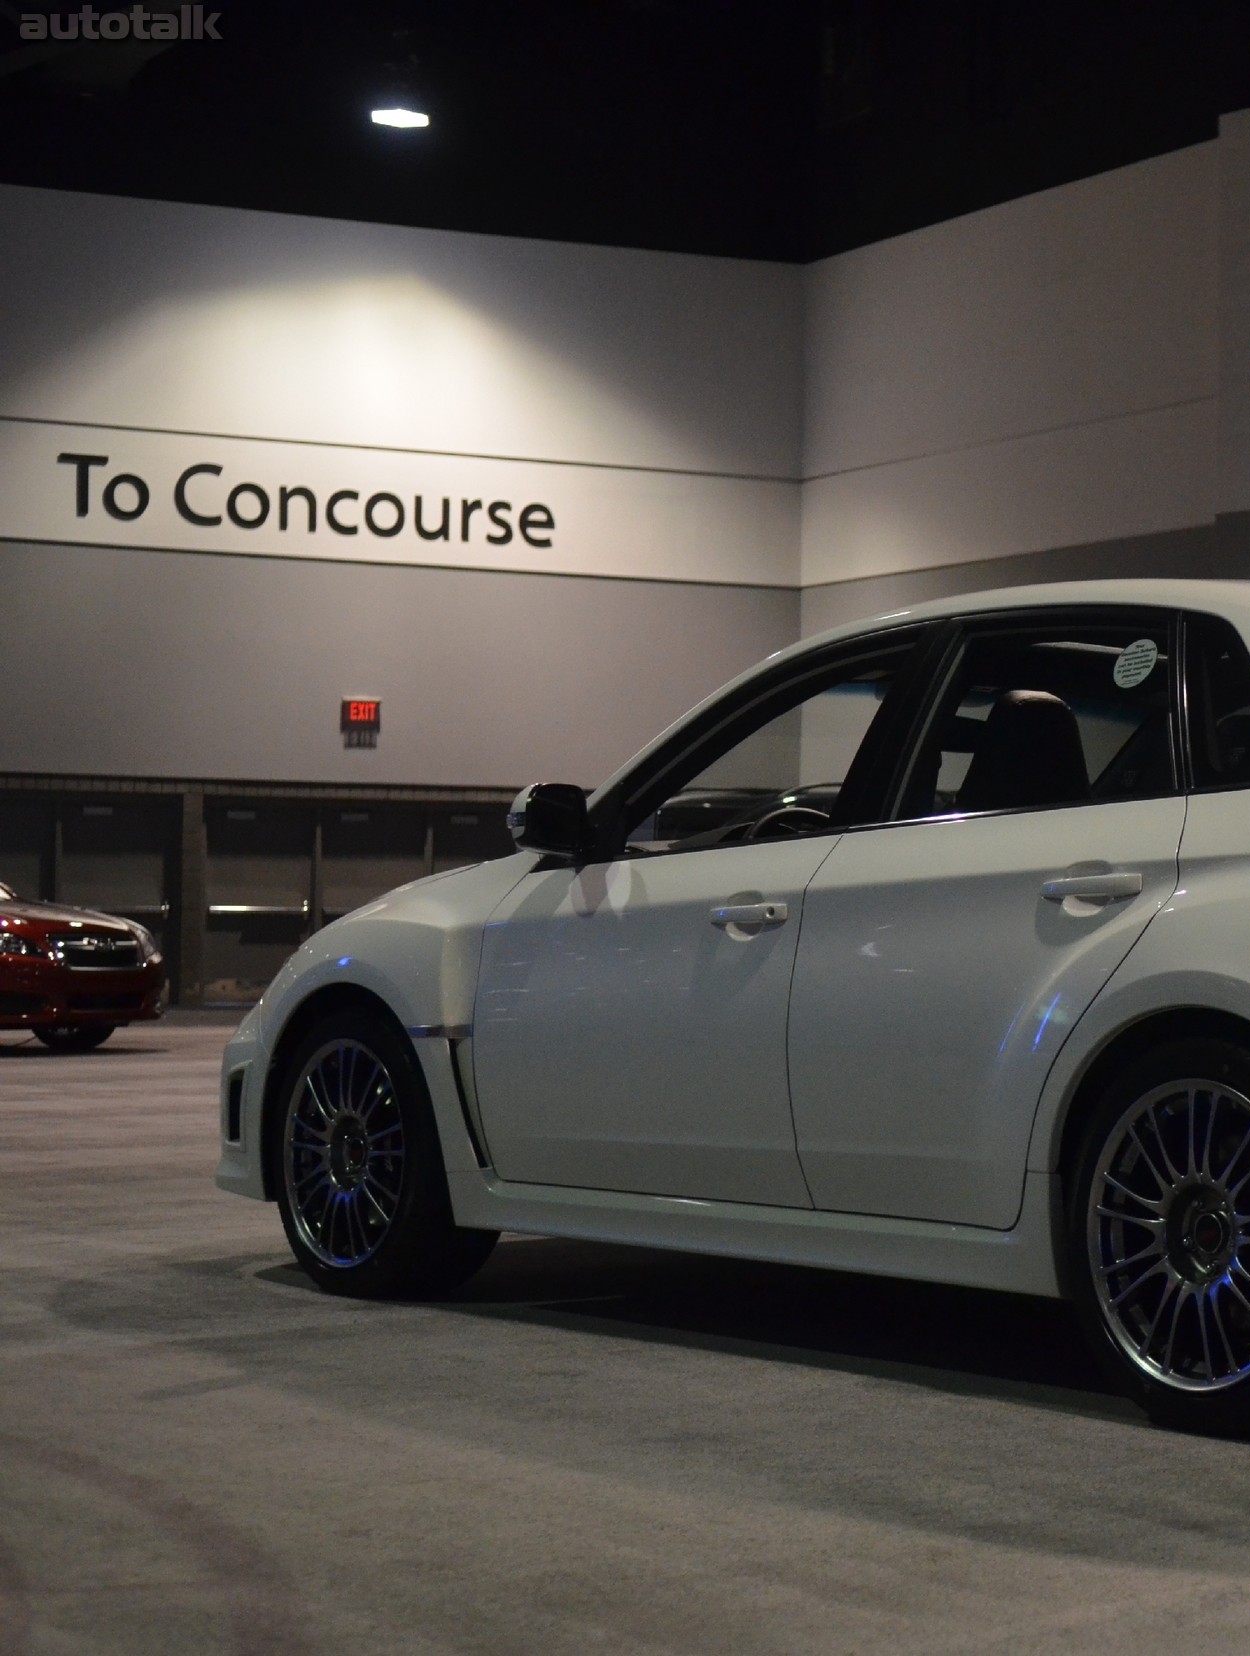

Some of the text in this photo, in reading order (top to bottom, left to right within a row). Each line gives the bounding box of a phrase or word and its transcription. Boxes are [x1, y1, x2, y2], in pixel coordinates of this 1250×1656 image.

[57, 453, 556, 548] To Concourse
[350, 702, 376, 721] EXIT
